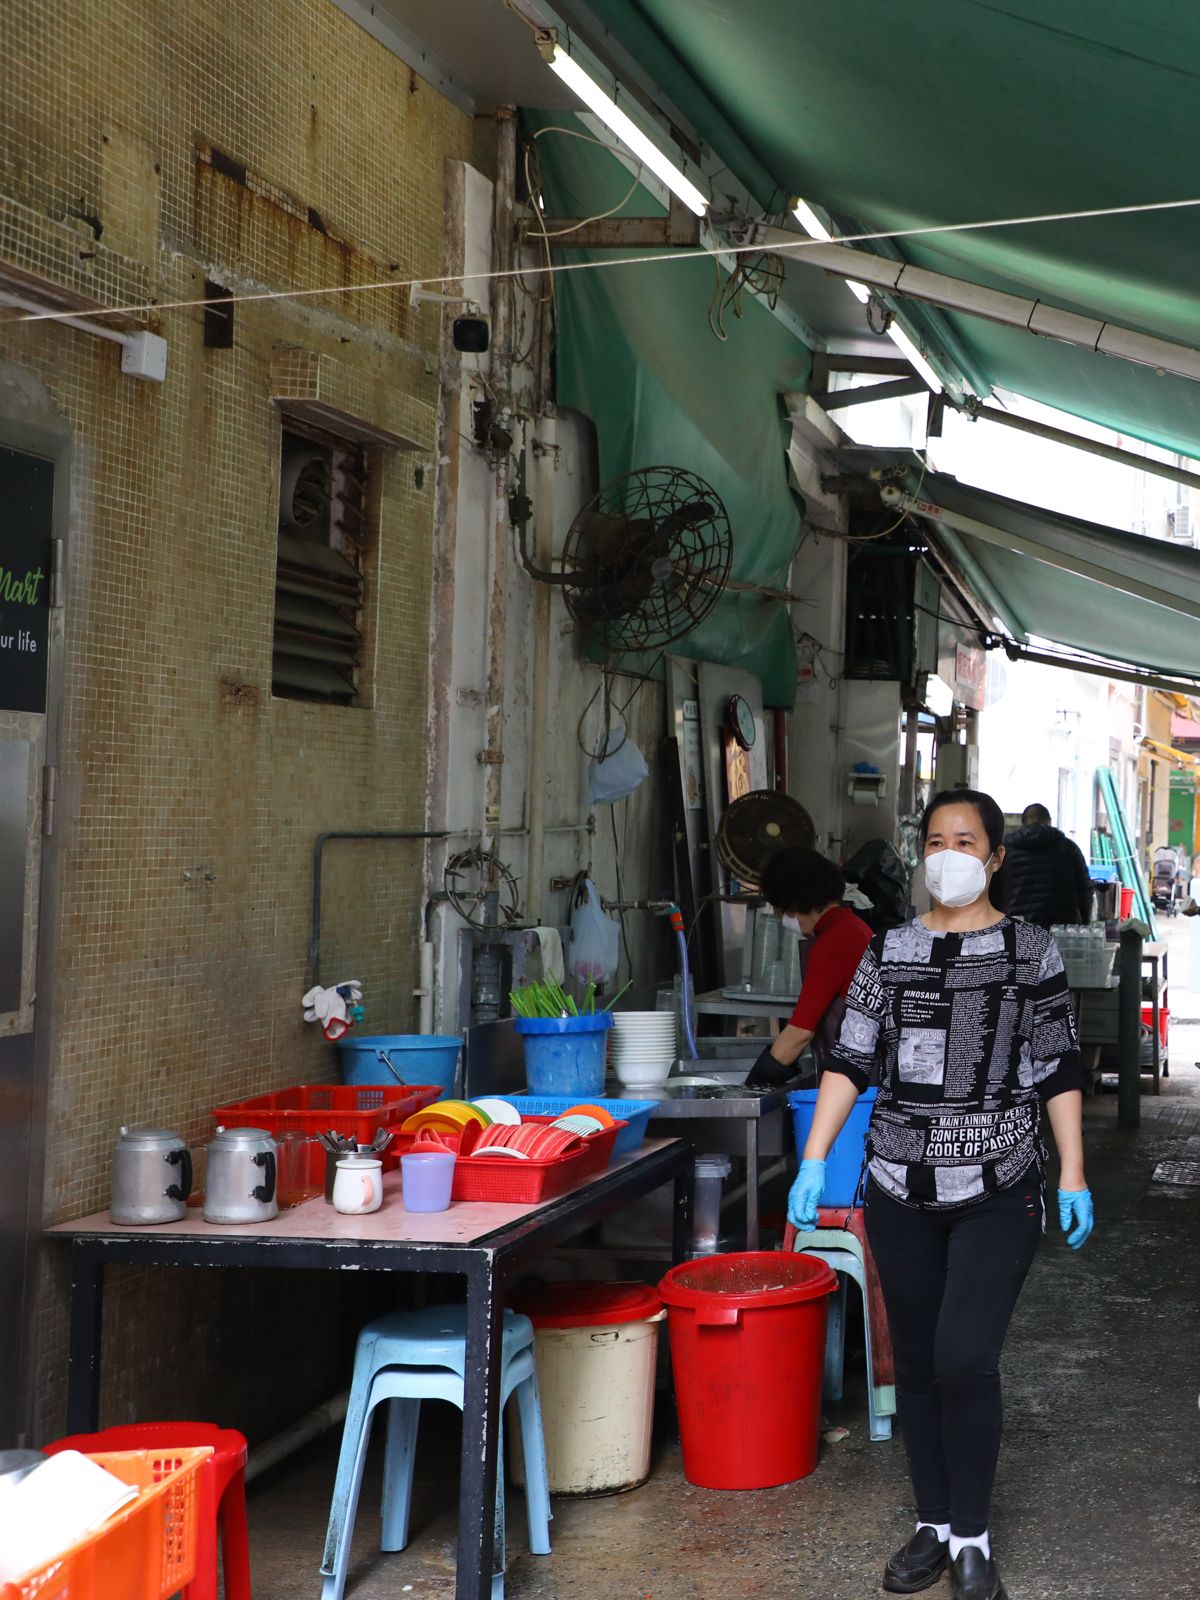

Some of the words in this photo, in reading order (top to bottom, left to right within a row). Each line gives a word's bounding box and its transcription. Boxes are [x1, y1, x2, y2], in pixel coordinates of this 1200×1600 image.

[18, 629, 37, 653] life
[903, 990, 940, 1000] DINOSAUR
[867, 995, 883, 1011] OF
[939, 1114, 992, 1126] MAINTAINING
[1000, 1121, 1015, 1134] ON
[926, 1142, 961, 1157] CODE
[964, 1142, 981, 1157] OF
